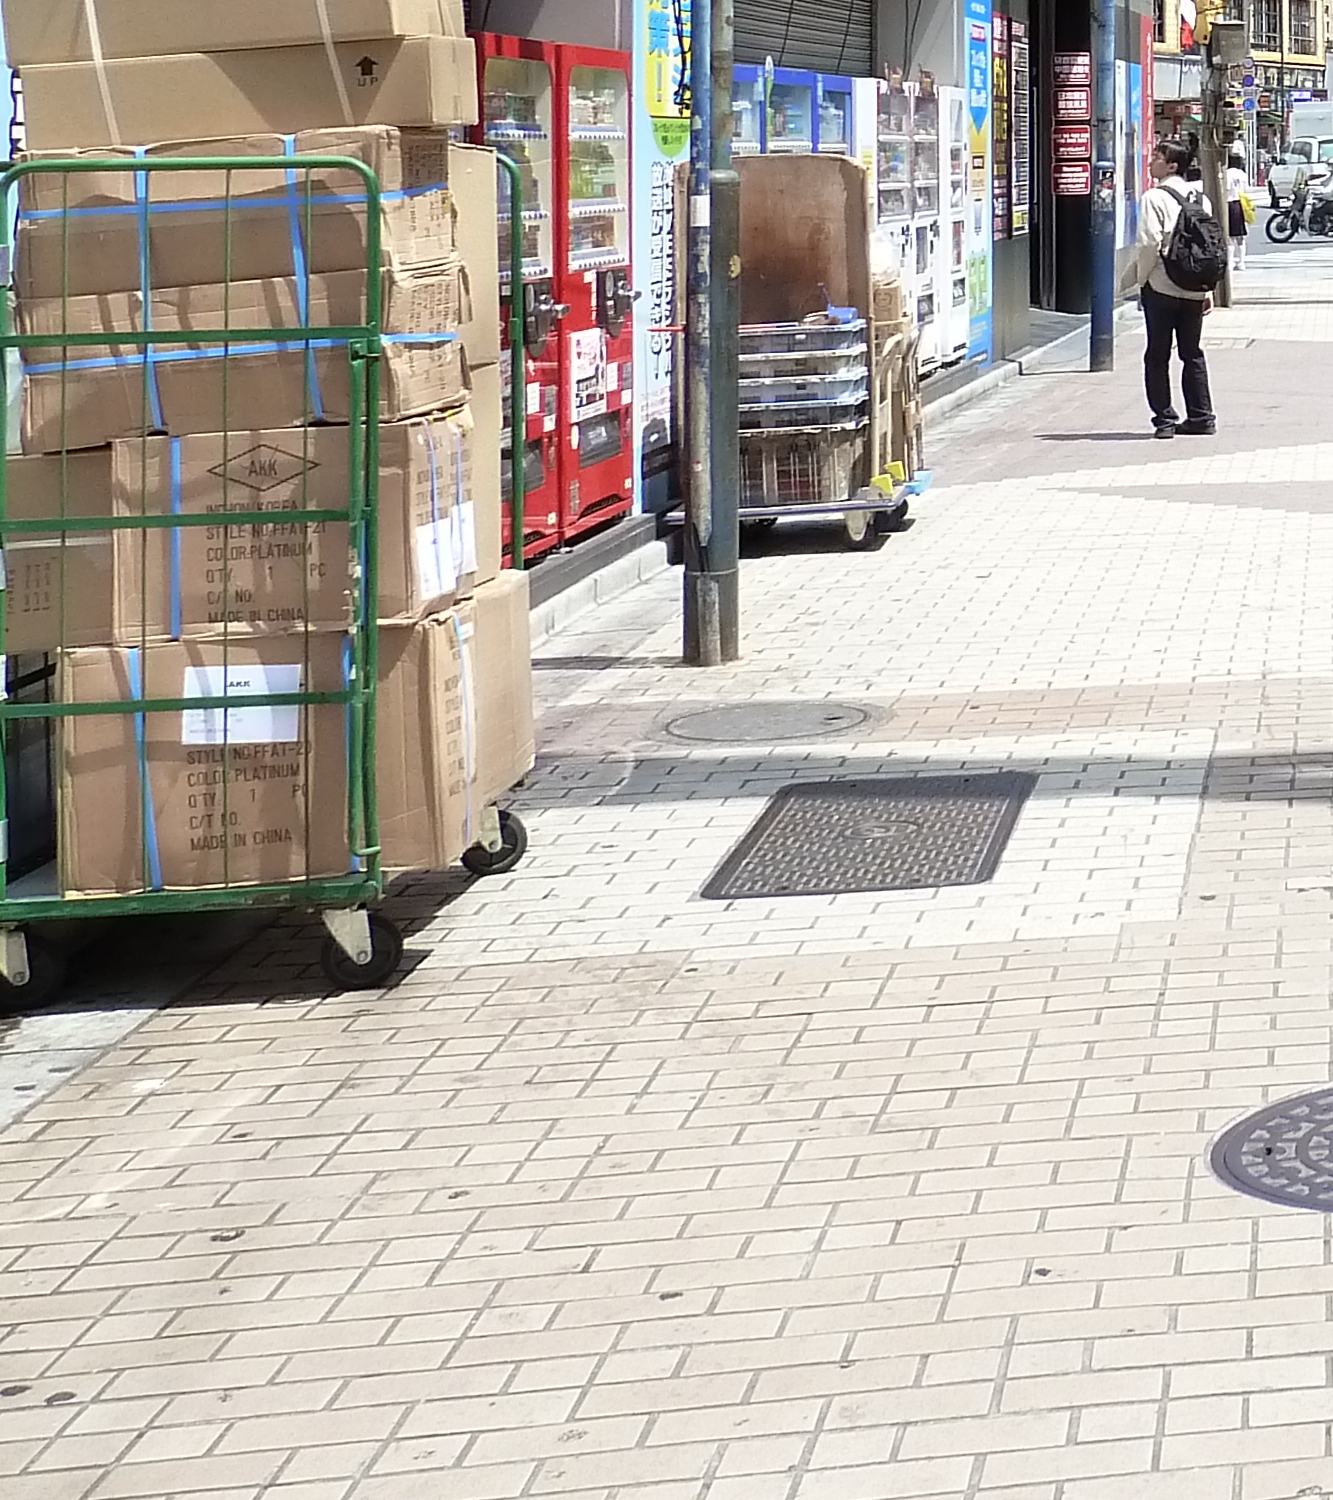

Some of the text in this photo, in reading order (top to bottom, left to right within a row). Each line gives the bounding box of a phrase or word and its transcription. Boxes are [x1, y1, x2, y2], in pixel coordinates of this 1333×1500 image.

[356, 77, 379, 87] UP
[248, 461, 279, 477] AKK
[309, 563, 326, 578] PC
[234, 832, 246, 848] IN
[253, 828, 293, 846] CHINA
